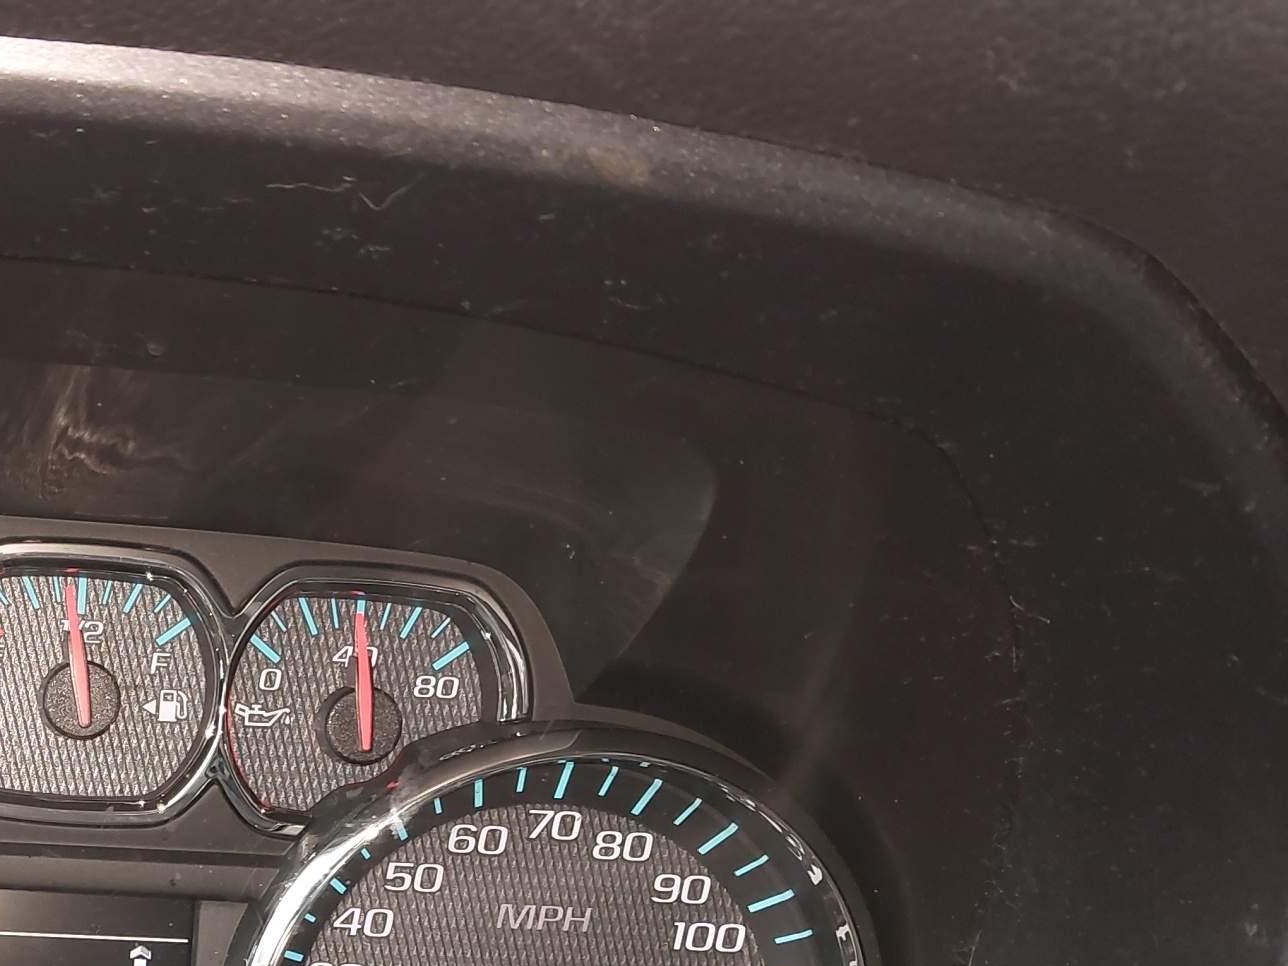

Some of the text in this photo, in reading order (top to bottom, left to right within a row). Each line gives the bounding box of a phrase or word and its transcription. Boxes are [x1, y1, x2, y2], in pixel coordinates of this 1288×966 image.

[149, 651, 171, 675] F
[258, 668, 283, 693] 0
[413, 676, 461, 700] 80
[447, 825, 509, 856] 60
[527, 810, 583, 841] 70
[592, 831, 654, 863] 80
[384, 863, 445, 894] 50
[651, 874, 712, 905] 90
[332, 908, 394, 938] 40
[495, 904, 593, 932] MPH
[672, 921, 746, 954] 100
